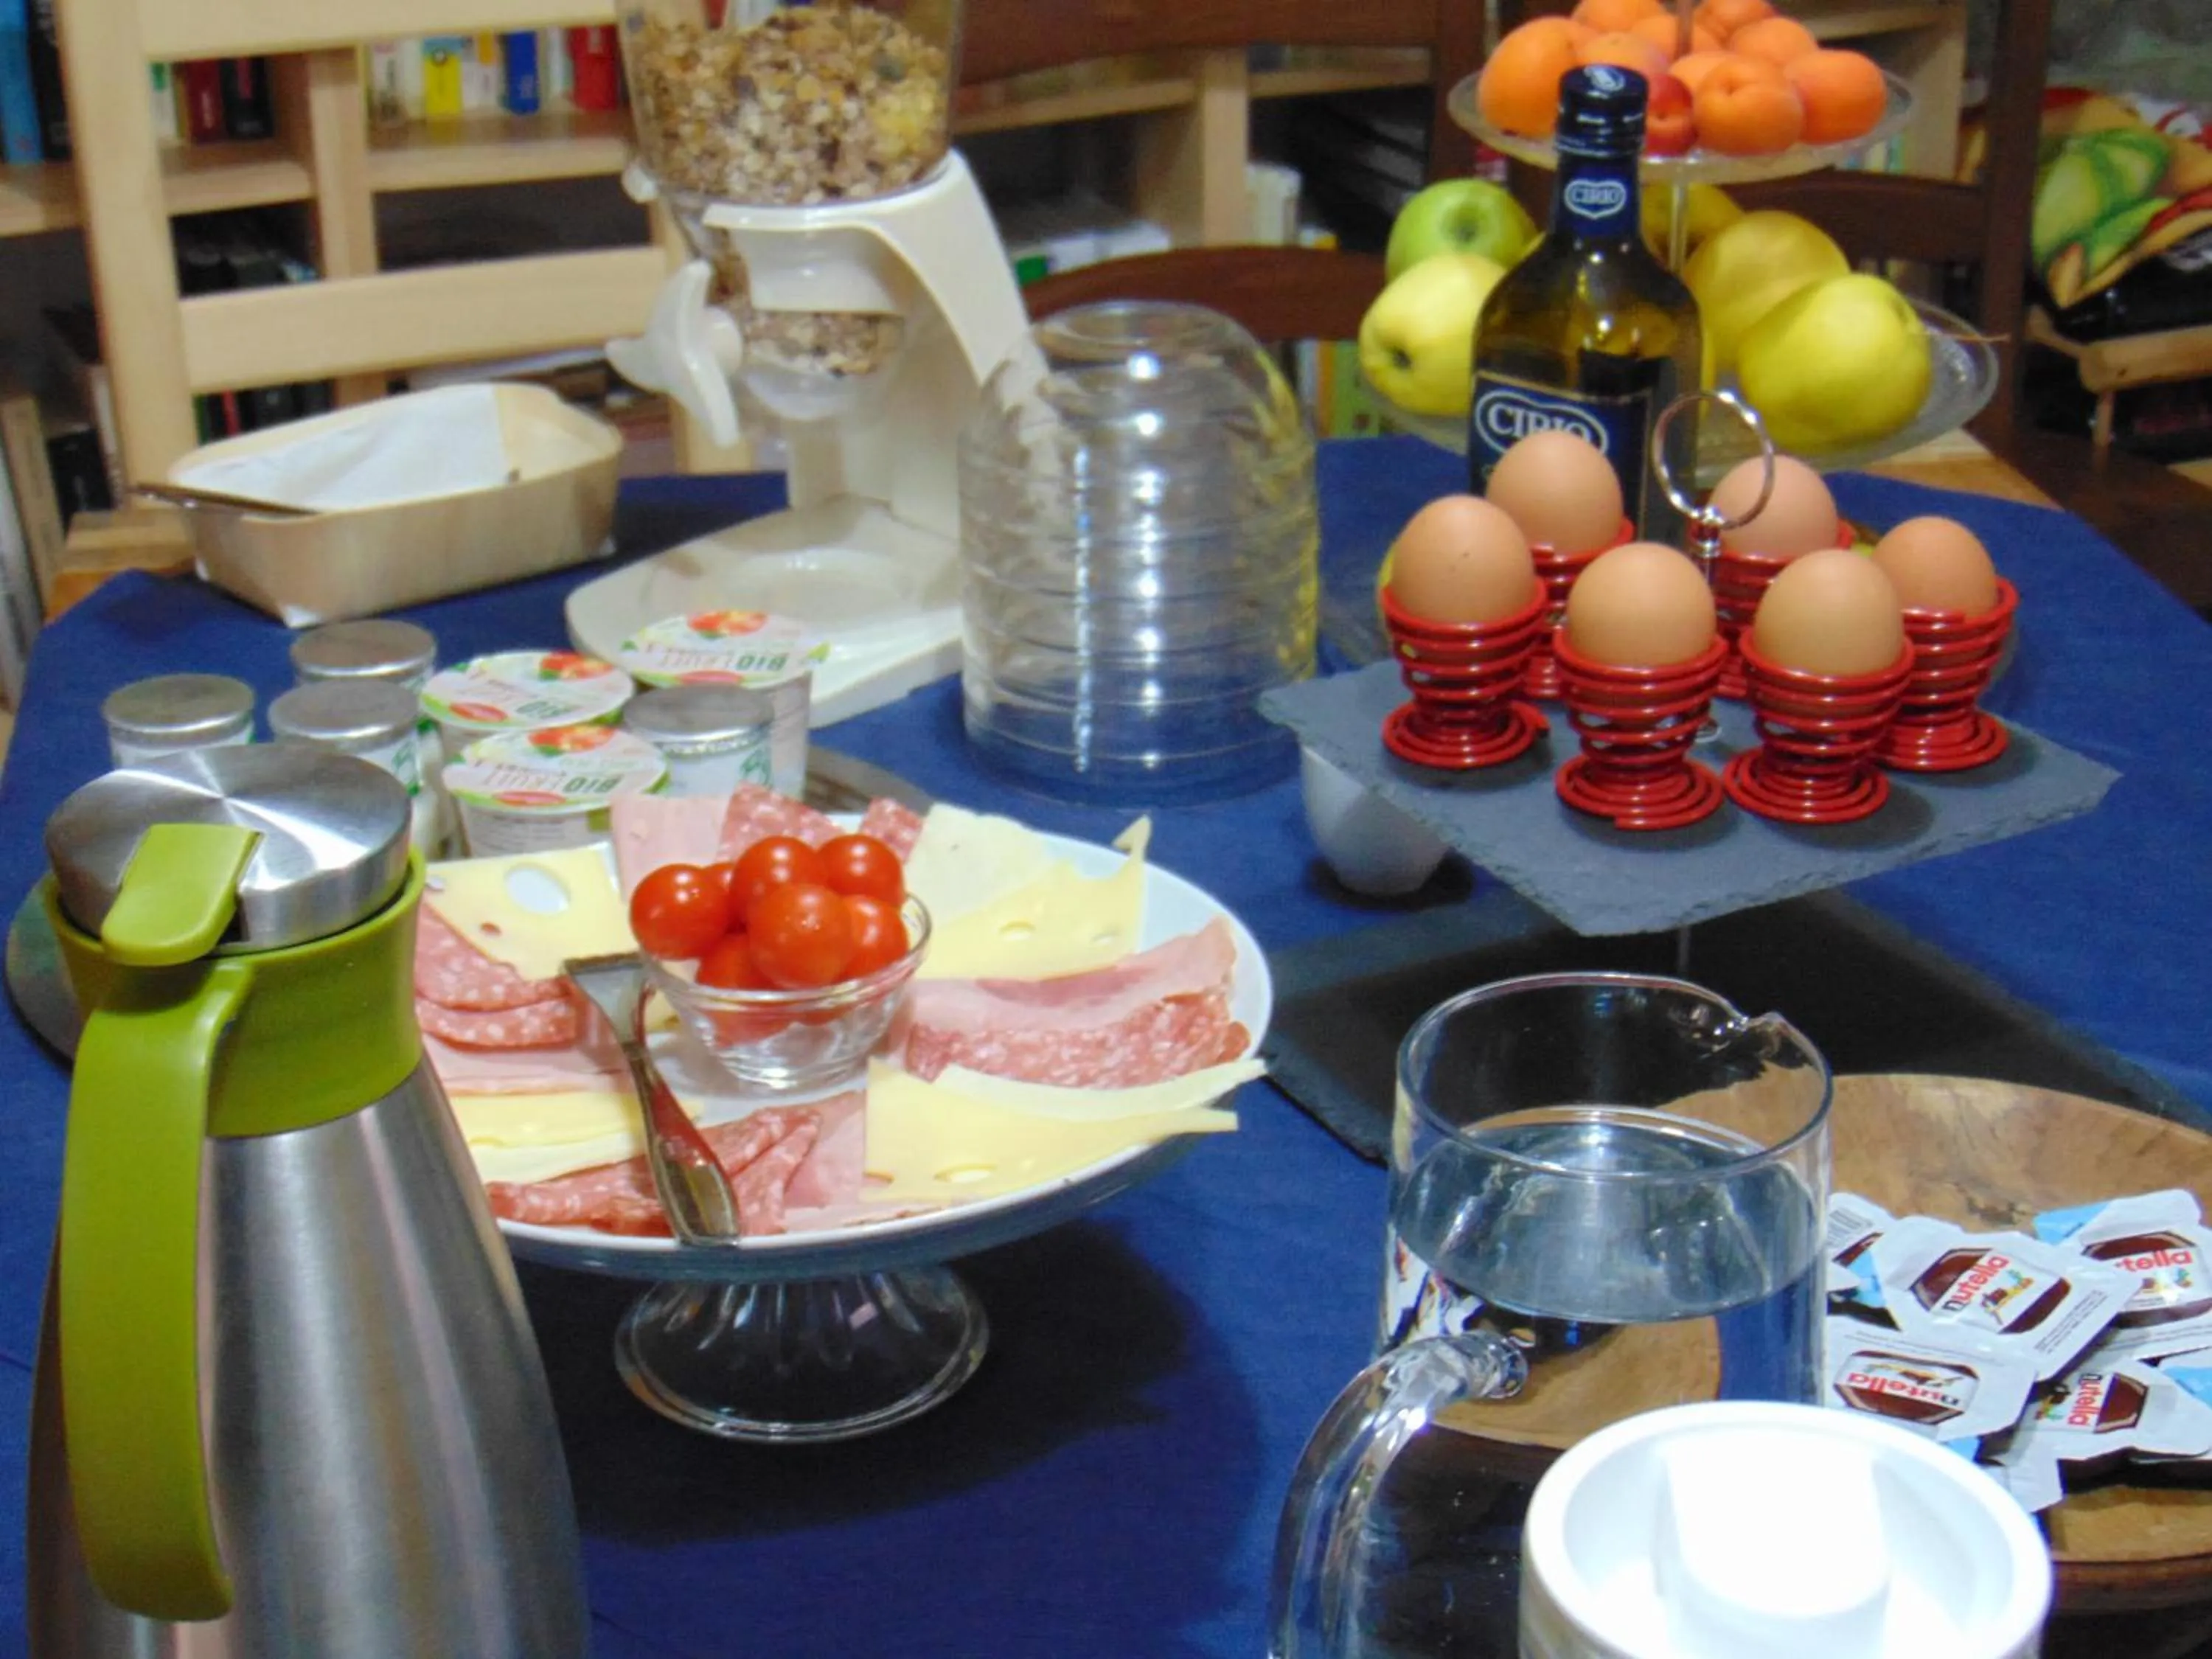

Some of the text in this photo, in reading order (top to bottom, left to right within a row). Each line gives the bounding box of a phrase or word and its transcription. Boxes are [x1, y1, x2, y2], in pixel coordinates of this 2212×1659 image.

[1571, 187, 1623, 204] CIRIO
[563, 775, 625, 793] BIO
[2115, 1249, 2193, 1273] tella
[1941, 1255, 2009, 1312] nutella
[1847, 1372, 1959, 1405] nutella
[2067, 1373, 2103, 1425] nutella
